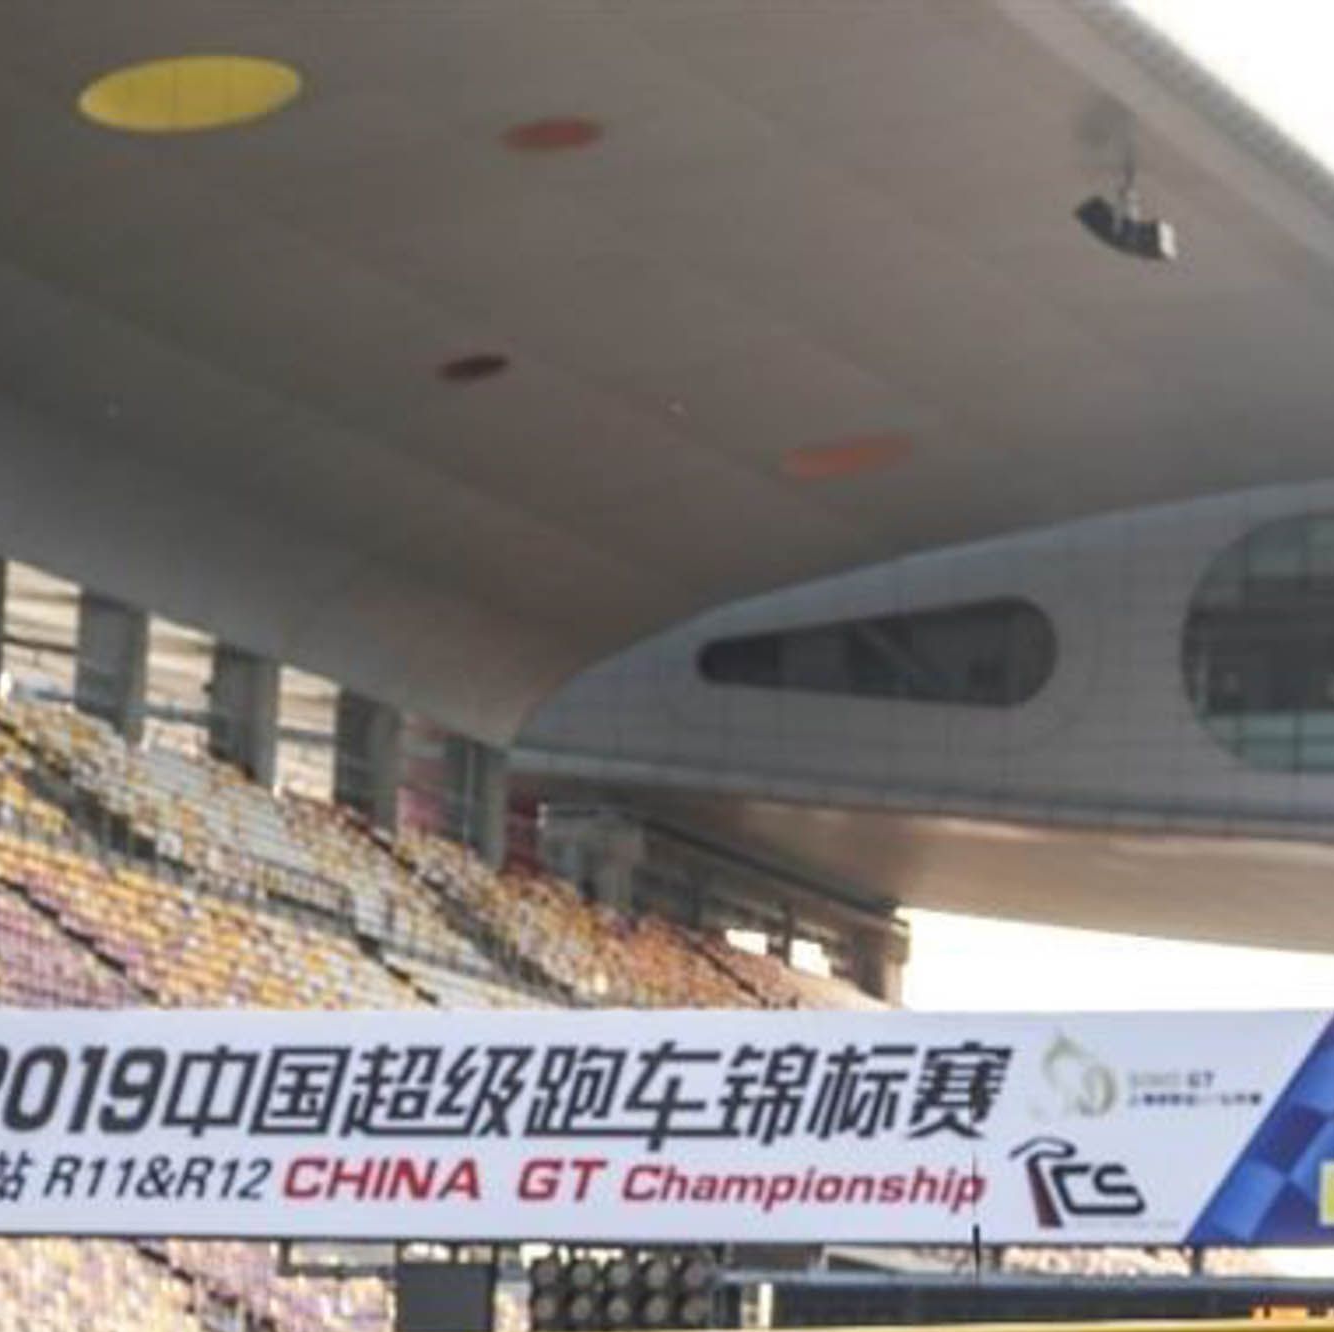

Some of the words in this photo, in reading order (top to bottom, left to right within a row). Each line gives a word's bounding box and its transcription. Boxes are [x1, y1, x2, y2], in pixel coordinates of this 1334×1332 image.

[42, 1155, 273, 1200] R11&R12
[282, 1156, 482, 1200] CHINA
[517, 1158, 608, 1201] GT
[621, 1159, 987, 1213] Championship
